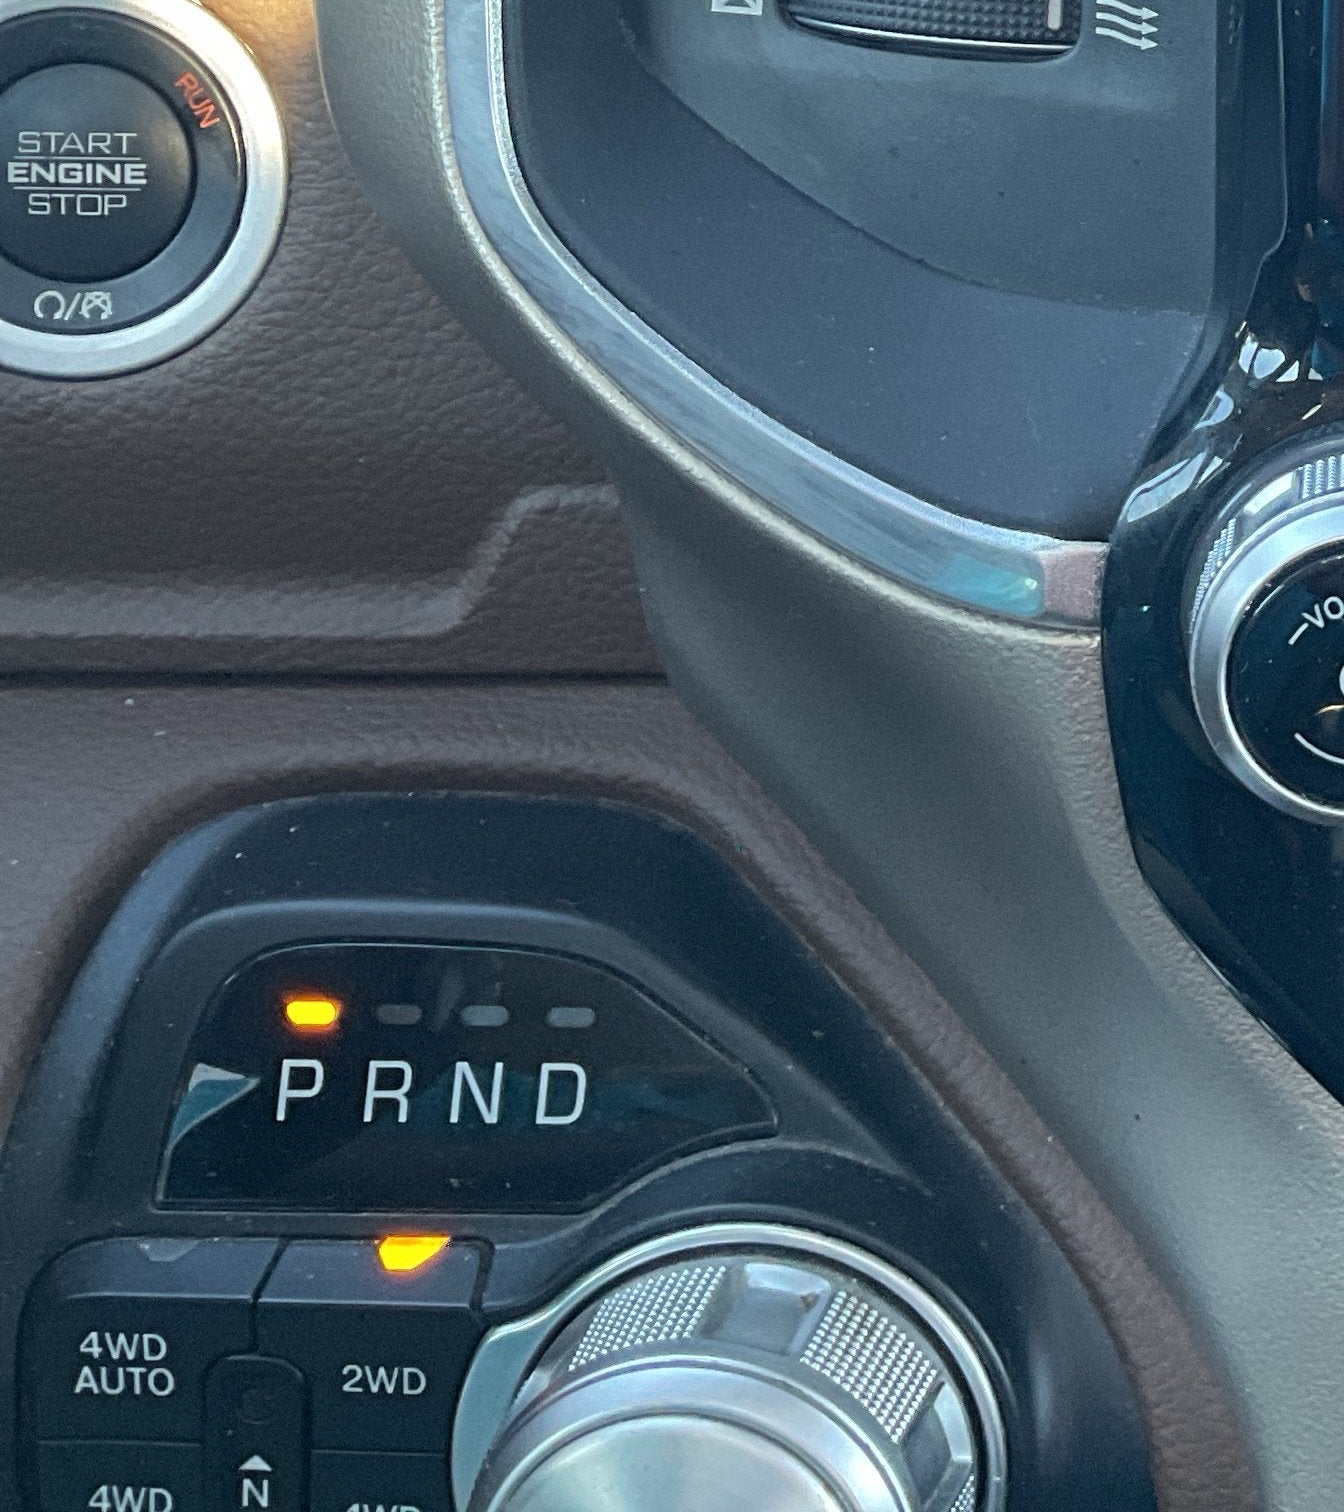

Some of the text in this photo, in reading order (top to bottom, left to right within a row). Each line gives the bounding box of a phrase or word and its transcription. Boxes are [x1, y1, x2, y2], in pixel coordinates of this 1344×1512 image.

[175, 72, 220, 129] RUN
[18, 131, 138, 154] START
[8, 162, 147, 184] ENGINE
[28, 193, 127, 216] STOP
[277, 1059, 586, 1124] P R N D
[80, 1332, 167, 1361] 4WD
[74, 1366, 174, 1396] AUTO
[342, 1365, 426, 1394] 2WD
[89, 1485, 172, 1512] 4WD
[242, 1478, 268, 1507] N
